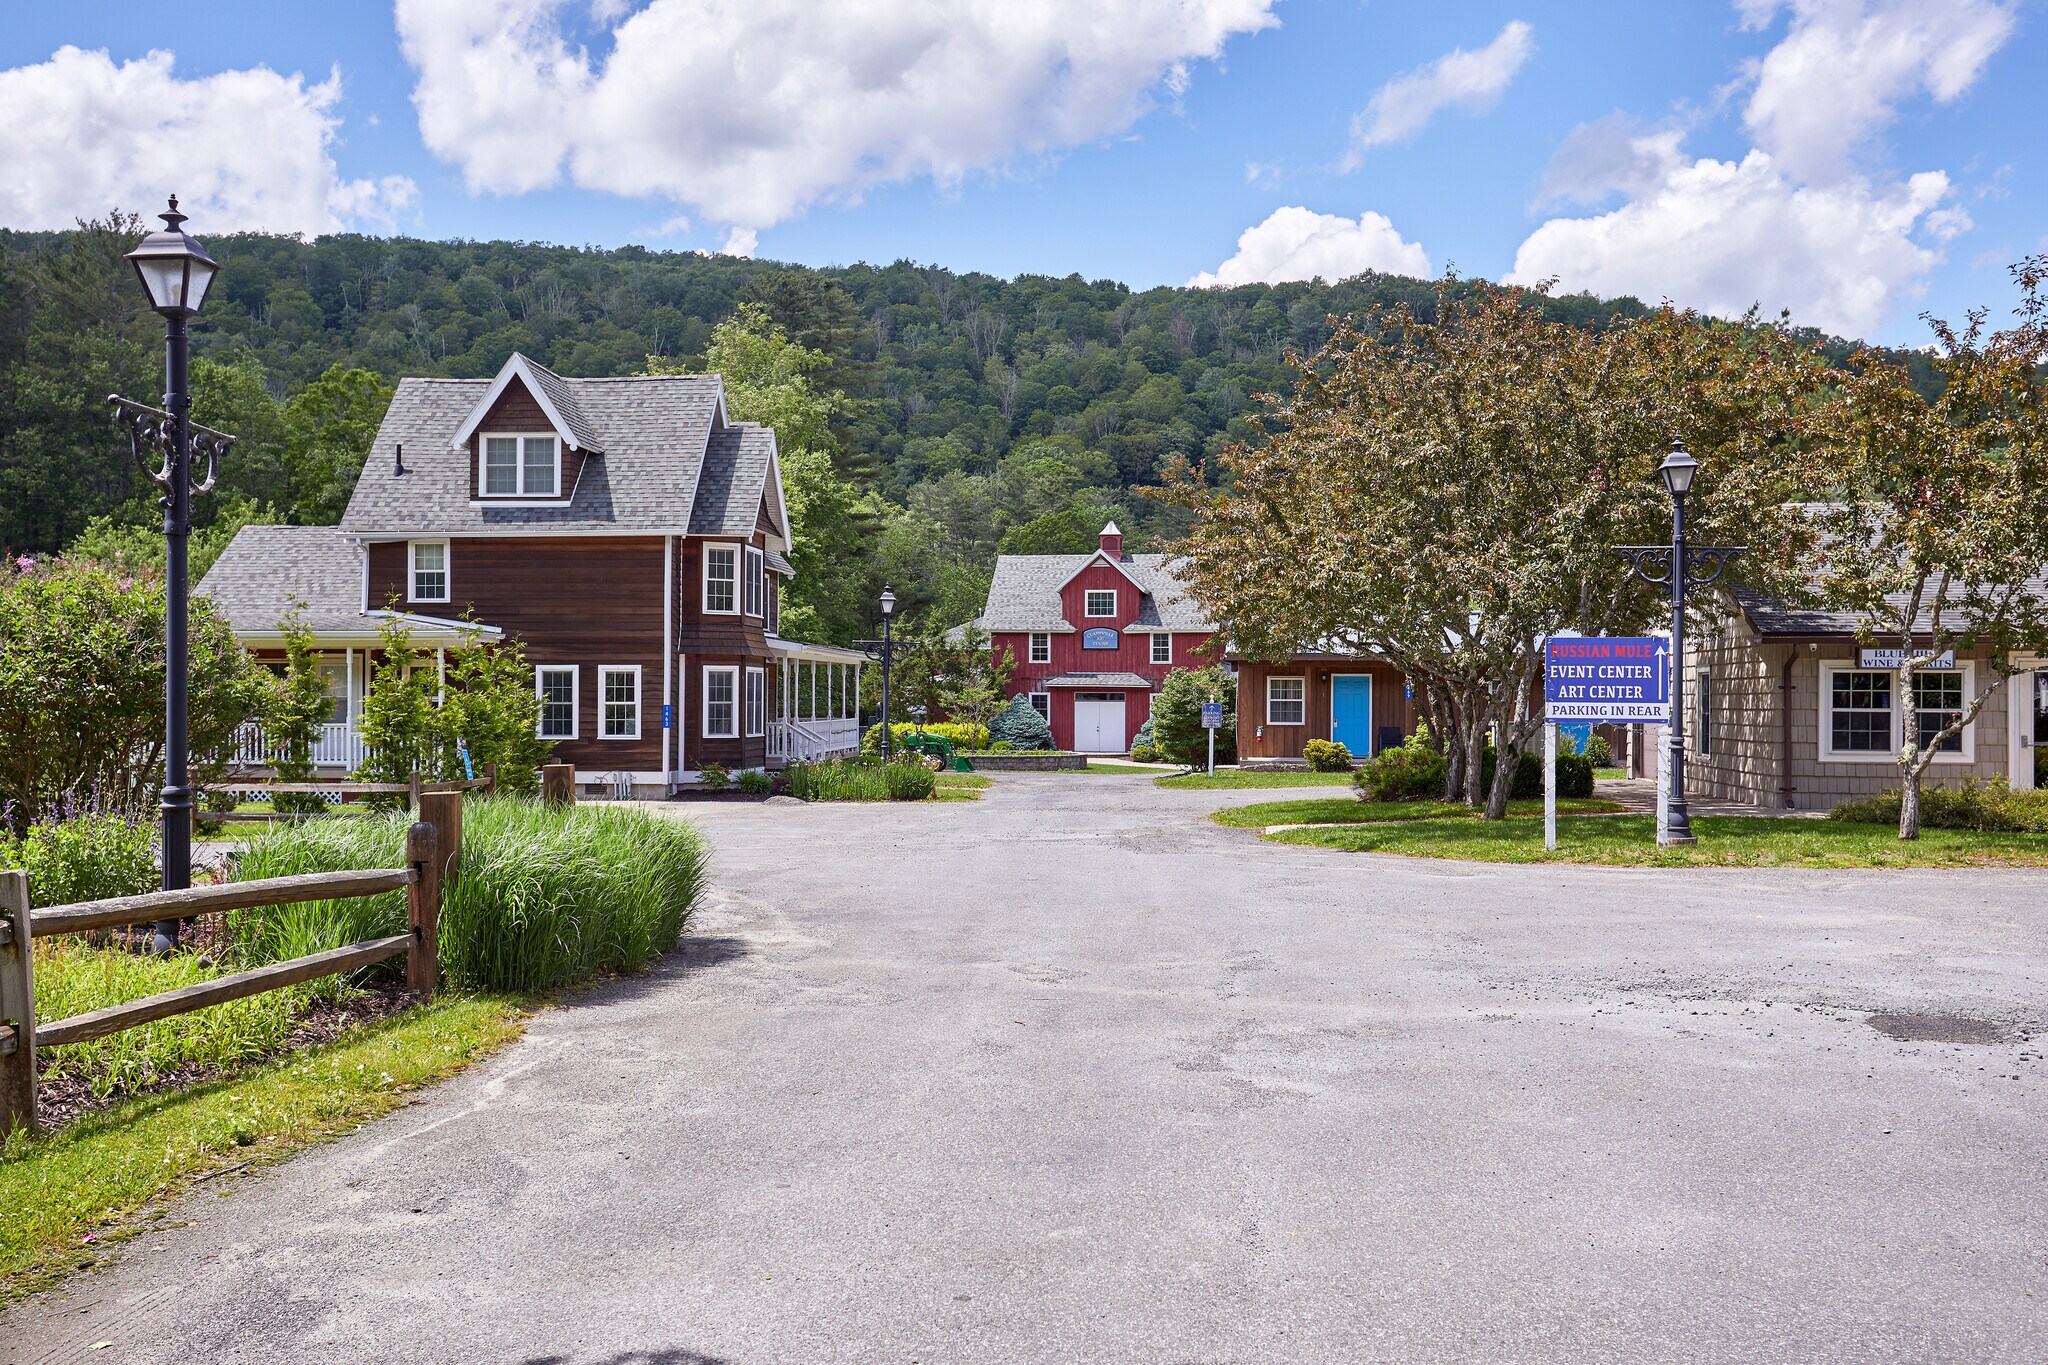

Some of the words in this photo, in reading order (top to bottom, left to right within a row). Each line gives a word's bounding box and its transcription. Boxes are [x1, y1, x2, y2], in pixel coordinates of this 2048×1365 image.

[1551, 645, 1610, 658] RUSSIAN
[1615, 645, 1651, 658] MULE
[1863, 659, 1894, 667] WINE
[1550, 665, 1595, 678] EVENT
[1598, 665, 1652, 679] CENTER
[1558, 685, 1586, 698] ART
[1589, 685, 1643, 699] CENTER
[1552, 705, 1607, 716] PARKING
[1610, 706, 1624, 716] IN
[1628, 706, 1661, 716] REAR
